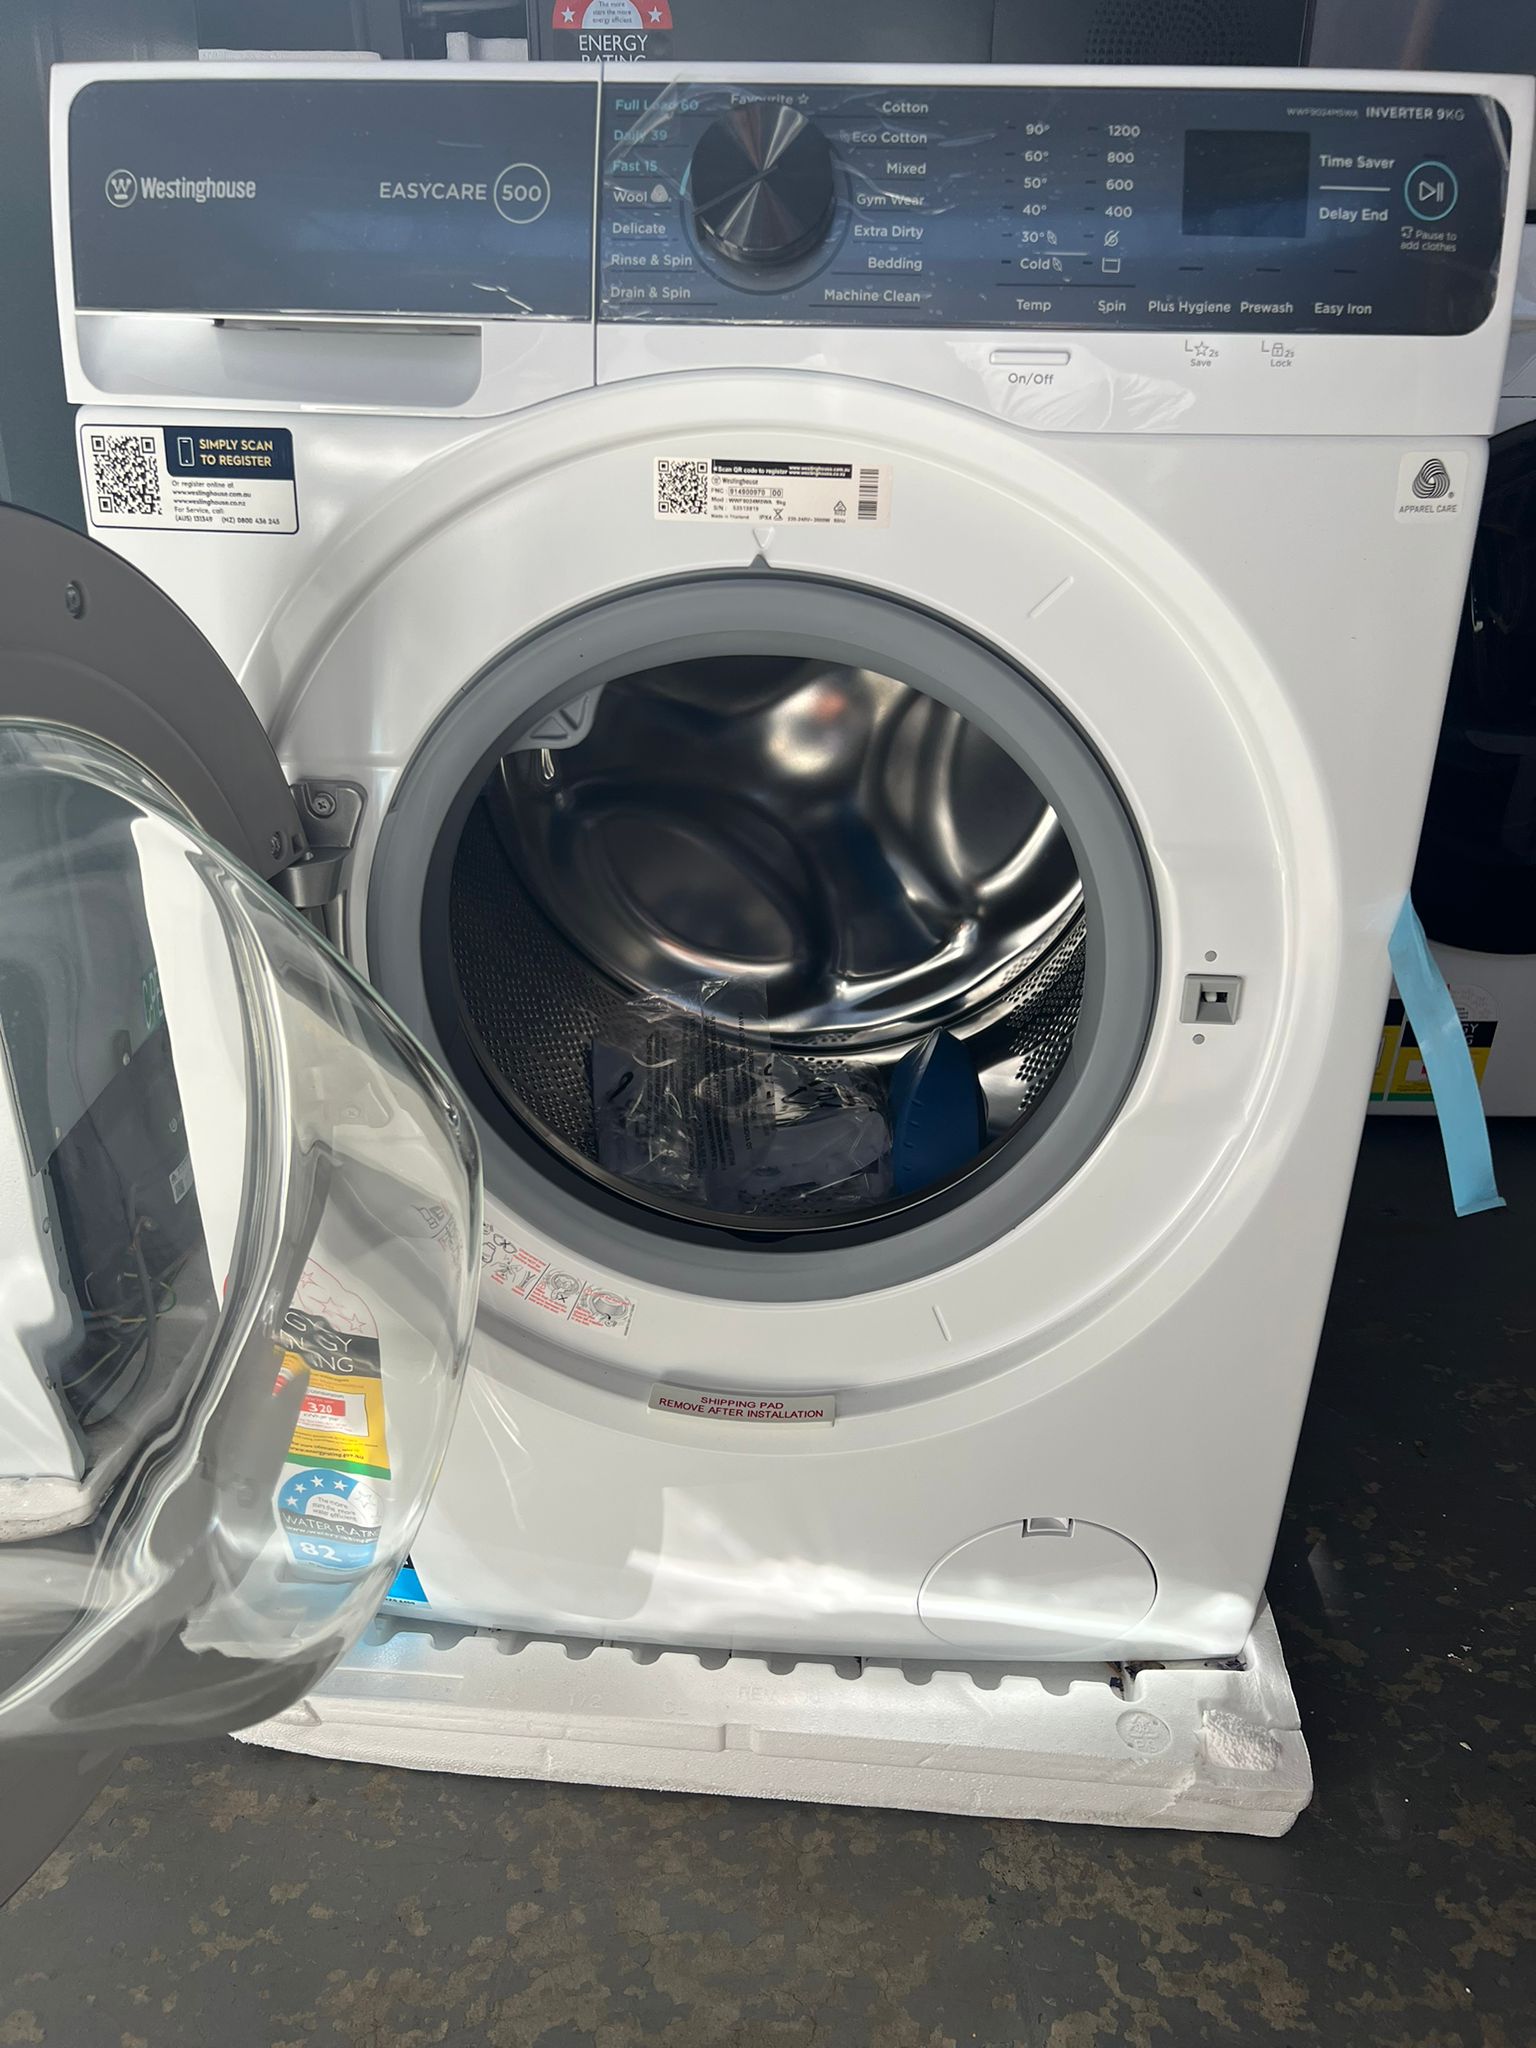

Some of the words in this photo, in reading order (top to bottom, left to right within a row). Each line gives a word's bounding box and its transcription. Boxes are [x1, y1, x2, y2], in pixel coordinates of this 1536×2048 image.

[579, 34, 648, 51] ENERGY
[615, 100, 640, 111] Full
[681, 101, 698, 111] 60
[882, 101, 928, 113] Cotton
[1365, 107, 1433, 119] INVERTER
[1437, 108, 1465, 121] 9KG
[652, 130, 667, 141] 39
[852, 131, 877, 143] Eco
[881, 132, 927, 144] Cotton
[1108, 125, 1141, 137] 1200
[1107, 152, 1134, 163] 800
[1320, 155, 1352, 168] Time
[1357, 156, 1395, 169] Saver
[613, 160, 640, 171] Fast
[645, 161, 657, 171] 15
[887, 162, 926, 175] Mixed
[140, 176, 256, 203] Westinghouse
[380, 182, 487, 200] EASYCARE
[502, 185, 542, 201] 500
[1106, 179, 1133, 191] 600
[614, 191, 648, 202] Wool
[856, 193, 886, 207] Gym
[1105, 206, 1132, 218] 400
[1319, 207, 1357, 222] Delay
[1362, 209, 1388, 221] End
[612, 223, 666, 234] Delicate
[854, 225, 887, 237] Extra
[892, 226, 923, 239] Dirty
[1415, 230, 1444, 240] Pause
[1446, 231, 1457, 240] to
[1401, 241, 1419, 250] add
[1422, 242, 1457, 252] clothes
[611, 254, 646, 265] Rinse
[651, 255, 659, 265] &
[664, 255, 692, 267] Spin
[868, 257, 922, 271] Bedding
[1020, 258, 1050, 270] Cold
[610, 287, 645, 298] Drain
[649, 287, 658, 298] &
[662, 287, 691, 300] Spin
[824, 289, 879, 301] Machine
[883, 290, 920, 302] Clean
[1016, 299, 1051, 313] Temp
[1098, 300, 1126, 313] Spin
[1148, 300, 1175, 313] Plus
[1179, 301, 1232, 315] Hygiene
[1240, 301, 1293, 314] Prewash
[1315, 302, 1343, 316] Easy
[1347, 303, 1372, 314] Iron
[1190, 359, 1211, 368] Save
[1270, 359, 1292, 368] Lock
[1008, 372, 1054, 385] On/Off
[199, 439, 238, 451] SIMPLY
[241, 440, 273, 451] SCAN
[200, 455, 216, 465] TO
[220, 455, 272, 467] REGISTER
[766, 468, 788, 476] register
[722, 478, 758, 486] Westinghouse
[172, 490, 252, 498] www.westinghouse.com.au
[173, 498, 246, 507] www.westinghouse.co.nz
[1399, 505, 1435, 513] APPAREL
[1436, 504, 1458, 513] CARE
[307, 1402, 333, 1414] 320
[658, 1397, 704, 1413] REMOVE
[708, 1406, 743, 1417] AFTER
[747, 1410, 824, 1419] INSTALLATION
[701, 1396, 756, 1409] SHIPPING
[759, 1401, 784, 1410] PAD
[282, 1512, 333, 1531] WATER
[300, 1542, 343, 1563] 82
